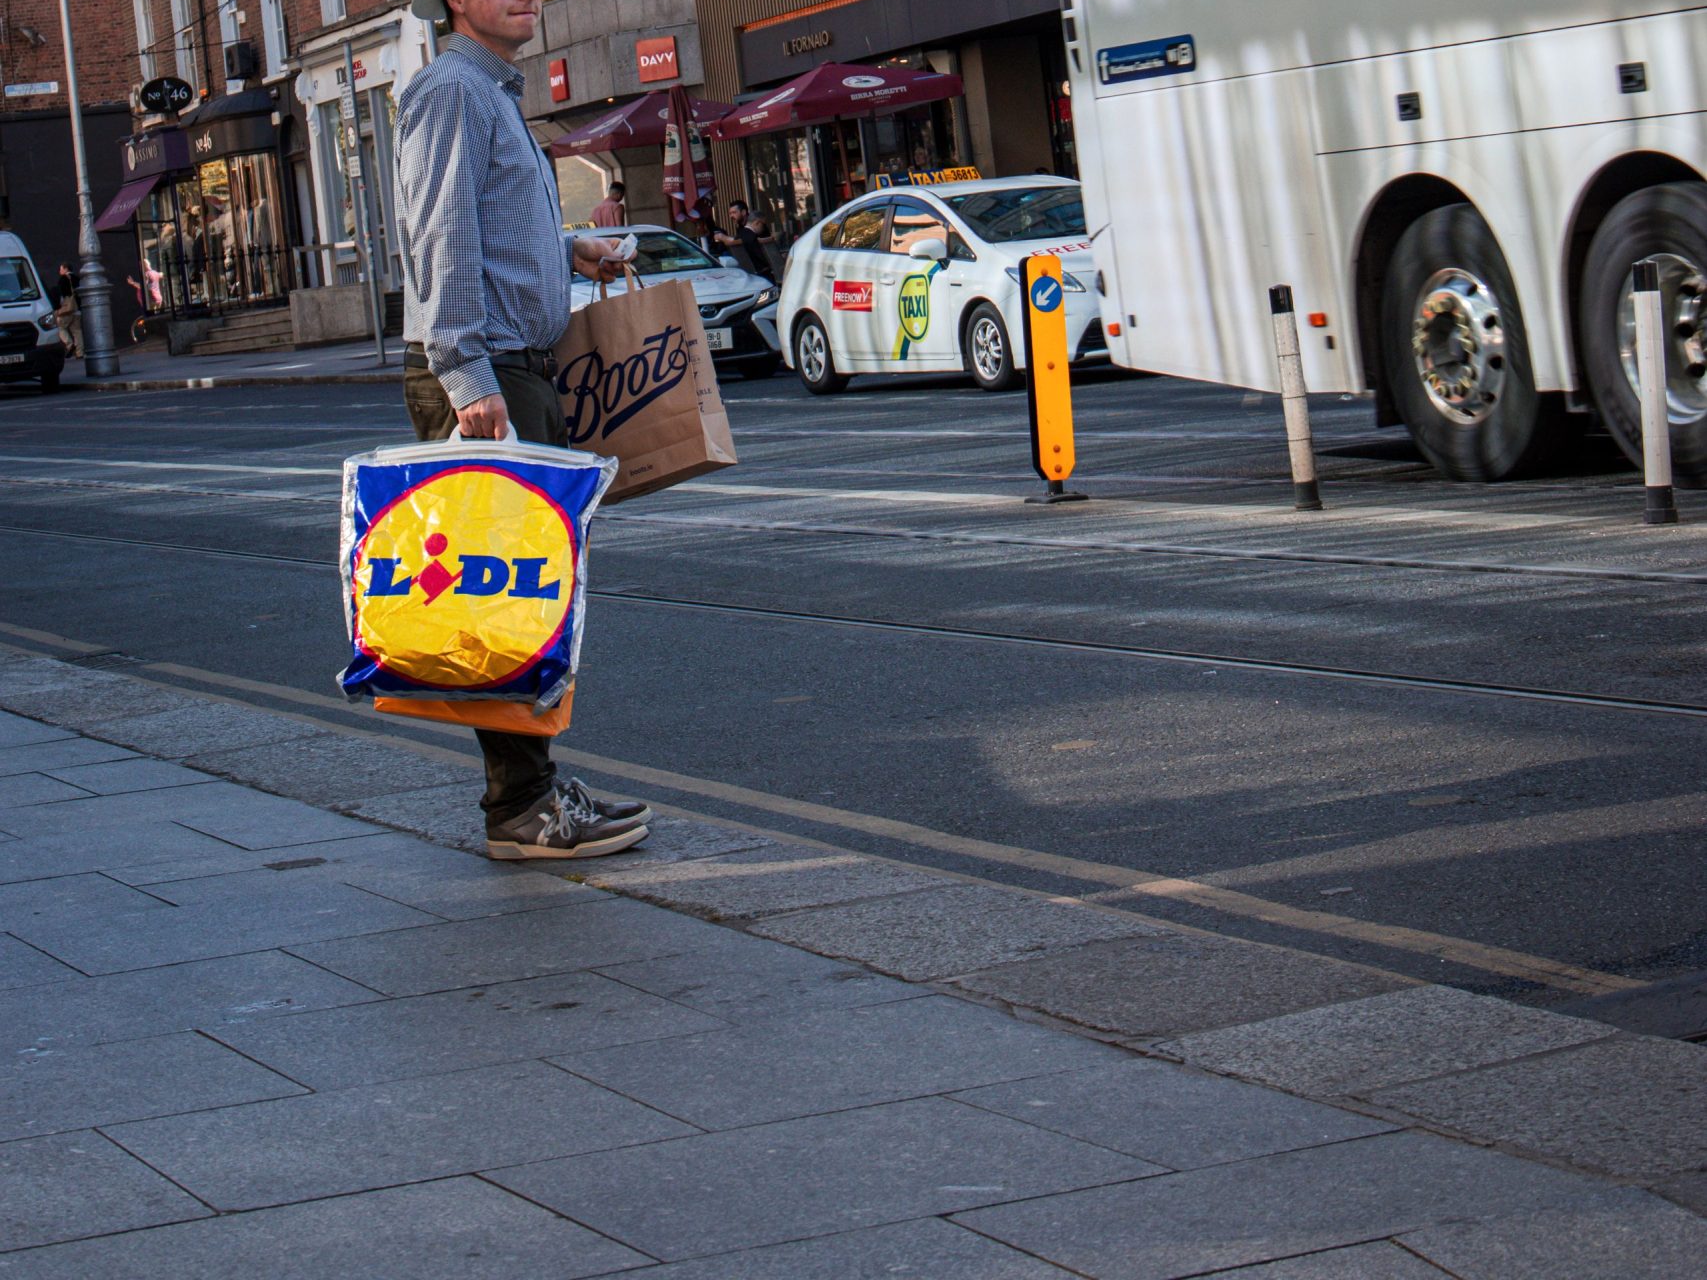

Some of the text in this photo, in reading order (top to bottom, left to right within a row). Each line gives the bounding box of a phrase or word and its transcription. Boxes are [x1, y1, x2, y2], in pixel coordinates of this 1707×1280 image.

[782, 30, 829, 56] IL FORNAIO
[640, 52, 673, 67] DAVY
[550, 74, 564, 88] DAVY
[170, 86, 188, 102] 46
[873, 85, 907, 97] MORETTI
[913, 170, 945, 187] TAXI
[950, 167, 978, 181] 36813
[901, 295, 927, 319] TAXI
[557, 325, 690, 443] Boots
